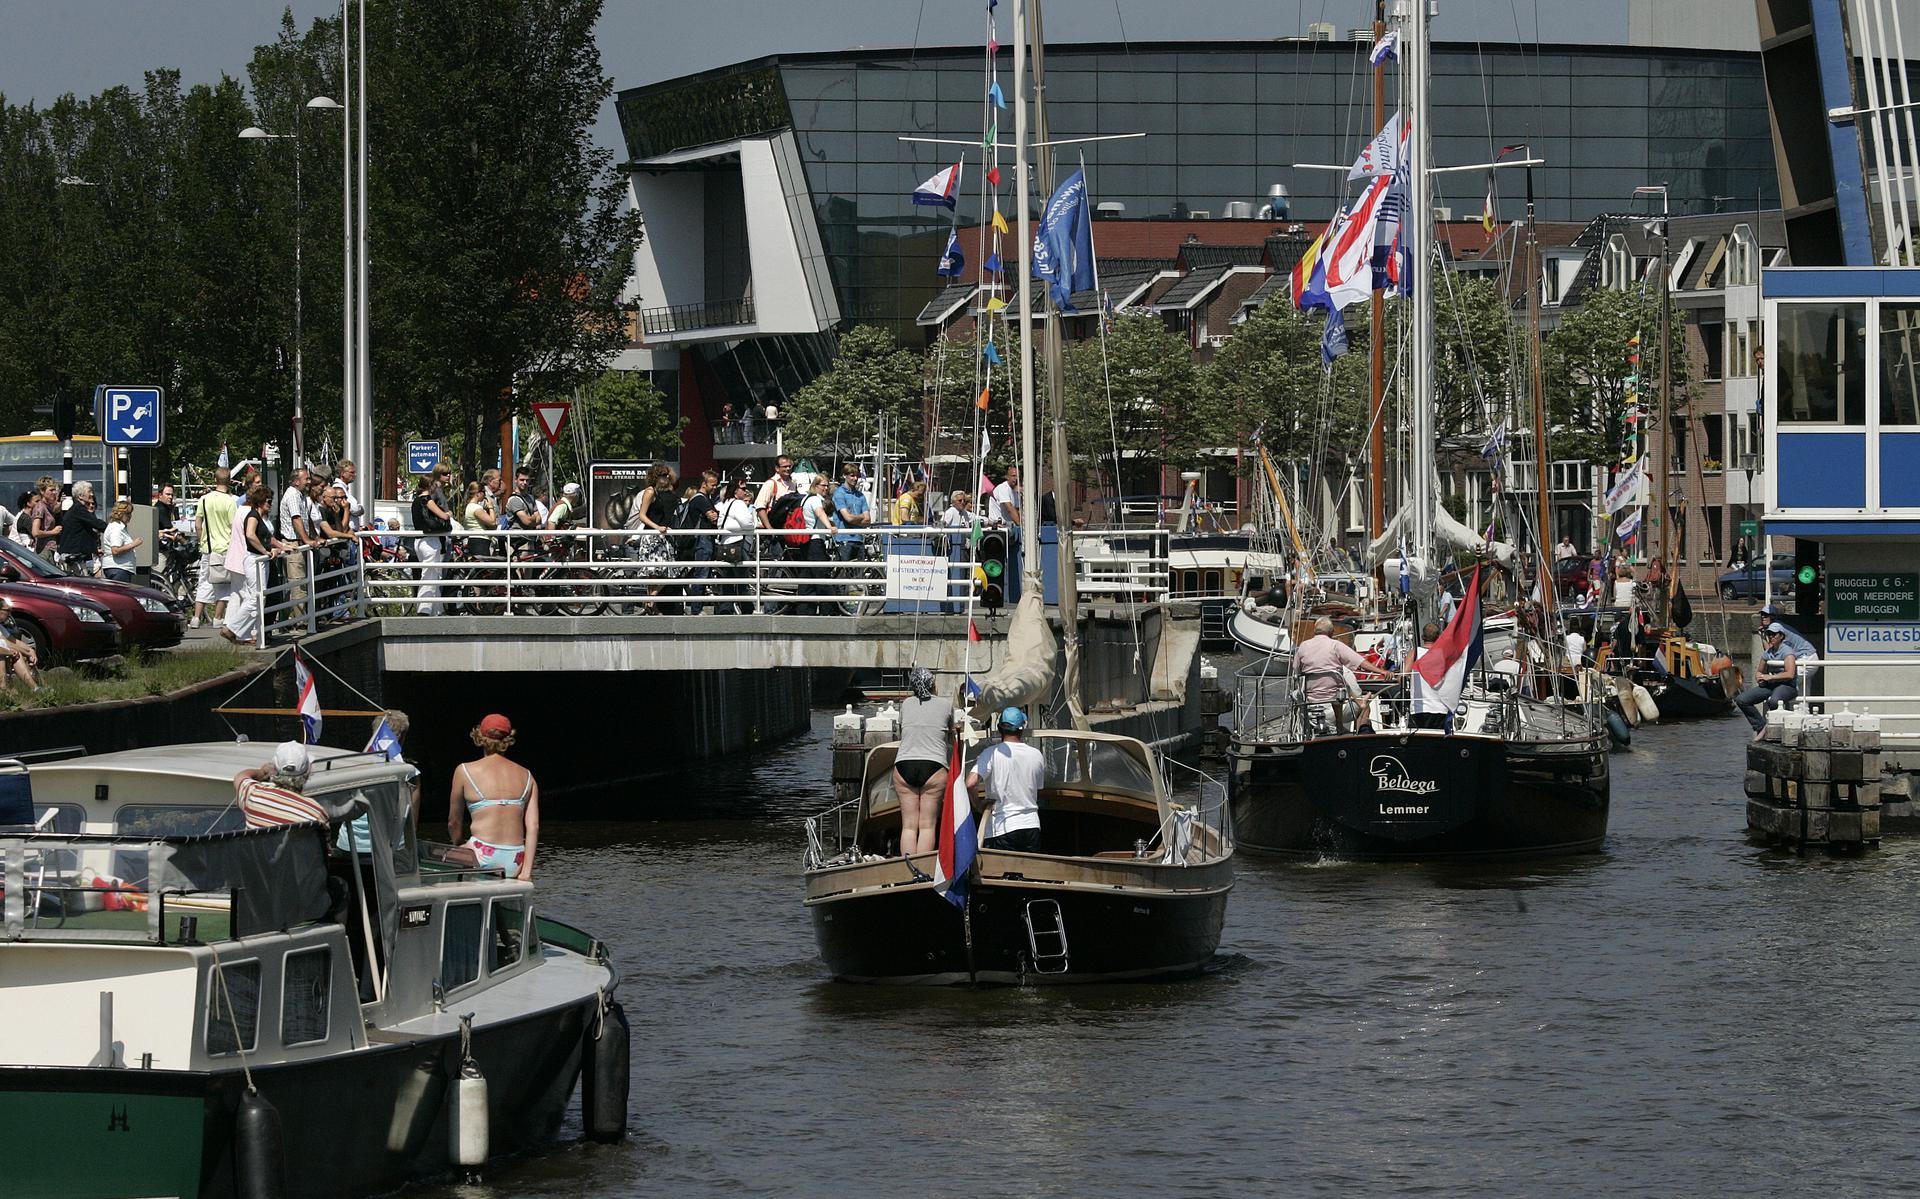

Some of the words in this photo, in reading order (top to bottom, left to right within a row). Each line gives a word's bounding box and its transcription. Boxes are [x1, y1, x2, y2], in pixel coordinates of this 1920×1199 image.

[112, 394, 132, 421] P
[1834, 579, 1877, 587] BRUGGELD
[1882, 578, 1890, 587] €
[1835, 592, 1858, 600] VOOR
[1863, 592, 1914, 600] MEERDERE
[1854, 605, 1900, 613] BRUGGEN
[1378, 775, 1437, 794] Beloega
[1380, 803, 1430, 815] Lemmer
